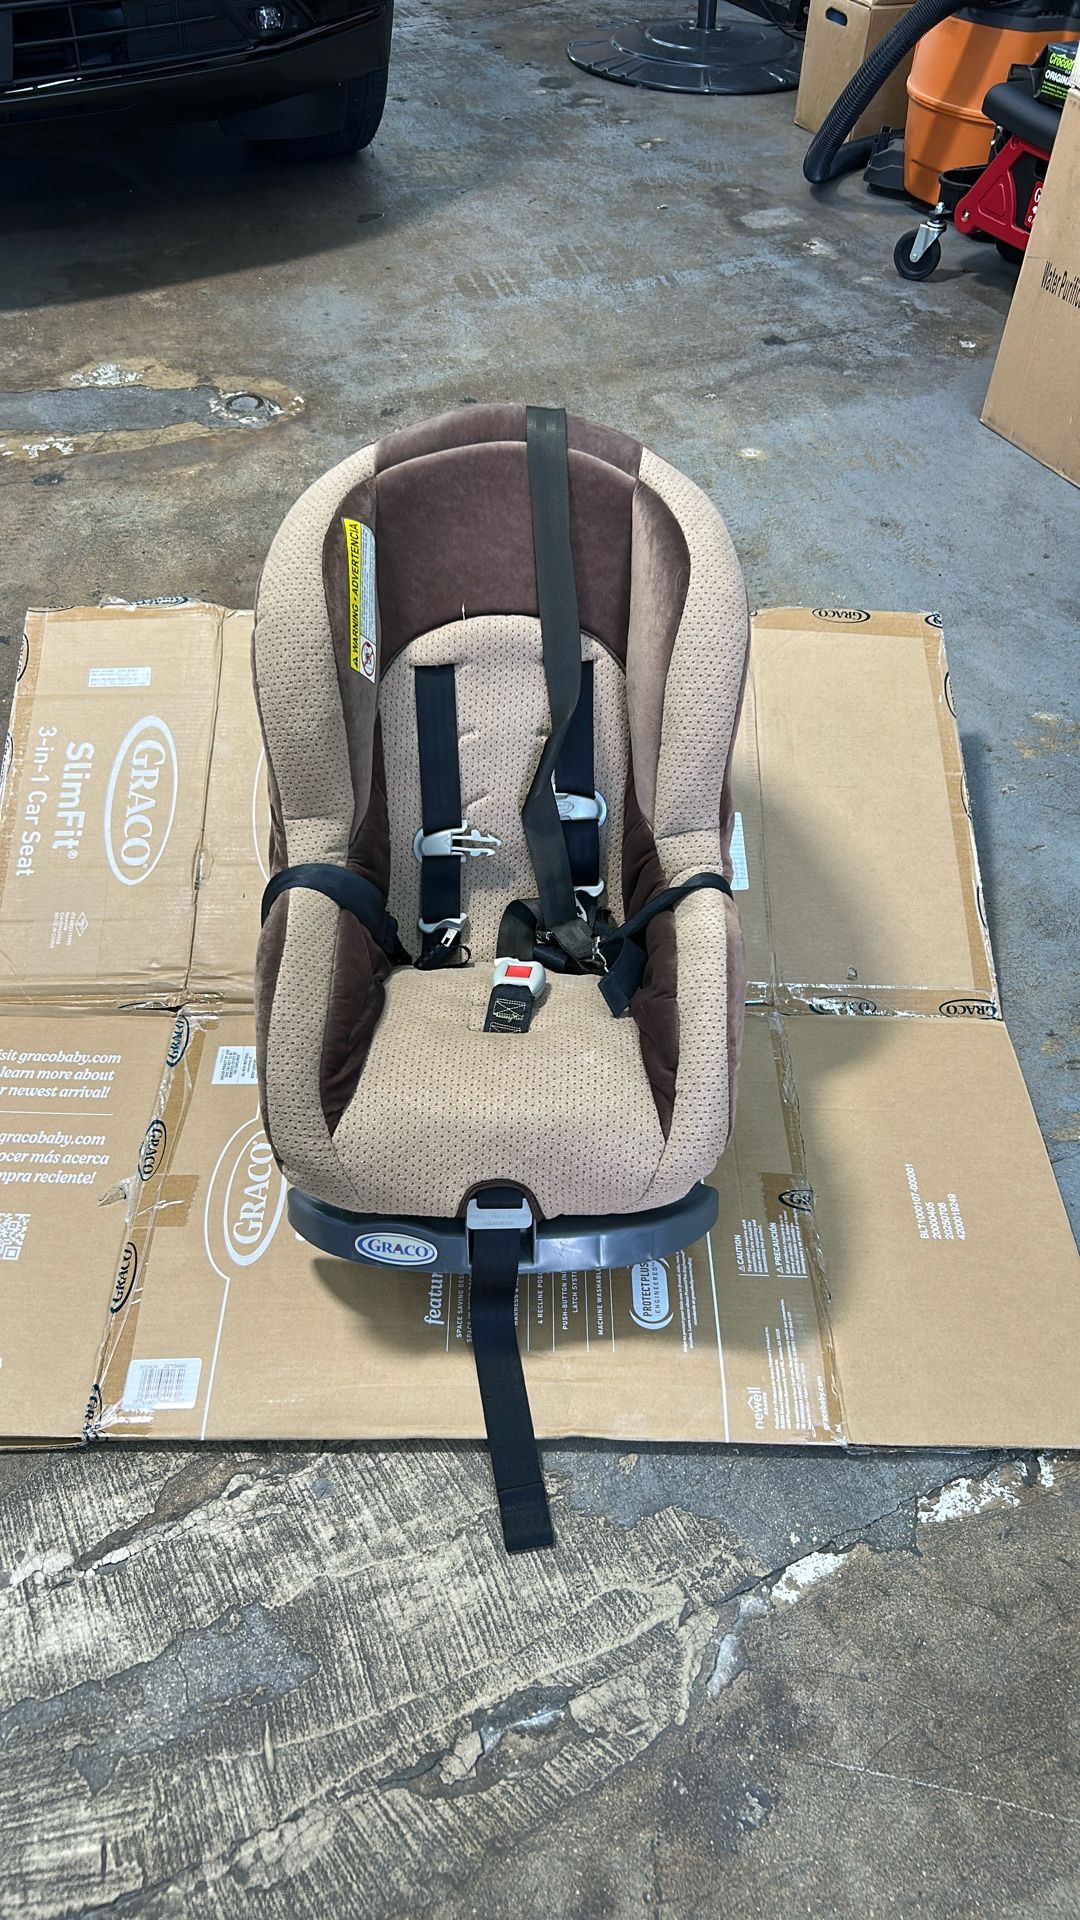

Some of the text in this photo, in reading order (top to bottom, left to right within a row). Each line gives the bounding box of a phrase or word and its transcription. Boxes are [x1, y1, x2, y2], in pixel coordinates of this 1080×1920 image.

[1041, 260, 1061, 295] Water
[350, 523, 359, 597] ADVERTENCIA
[351, 605, 359, 654] WARNING
[818, 609, 862, 621] GRACO
[16, 726, 57, 876] 3-in-1 Car Seat
[121, 739, 166, 867] GRACO
[17, 1051, 121, 1065] gracobaby.com
[0, 1066, 115, 1081] learn more about
[8, 1086, 58, 1097] newest
[60, 1086, 111, 1098] arrival!
[0, 1131, 105, 1147] gracobaby.com
[30, 1149, 61, 1163] más
[62, 1153, 110, 1165] acerca
[33, 1169, 97, 1184] reciente!
[233, 1142, 274, 1244] GRACO
[367, 1239, 429, 1257] GRACO
[734, 1235, 744, 1264] CAUTION
[769, 1222, 782, 1265] PRECAUCIÓN
[457, 1290, 465, 1314] SAVING
[640, 1262, 652, 1317] PROTECTPLUS
[746, 1387, 764, 1429] newell
